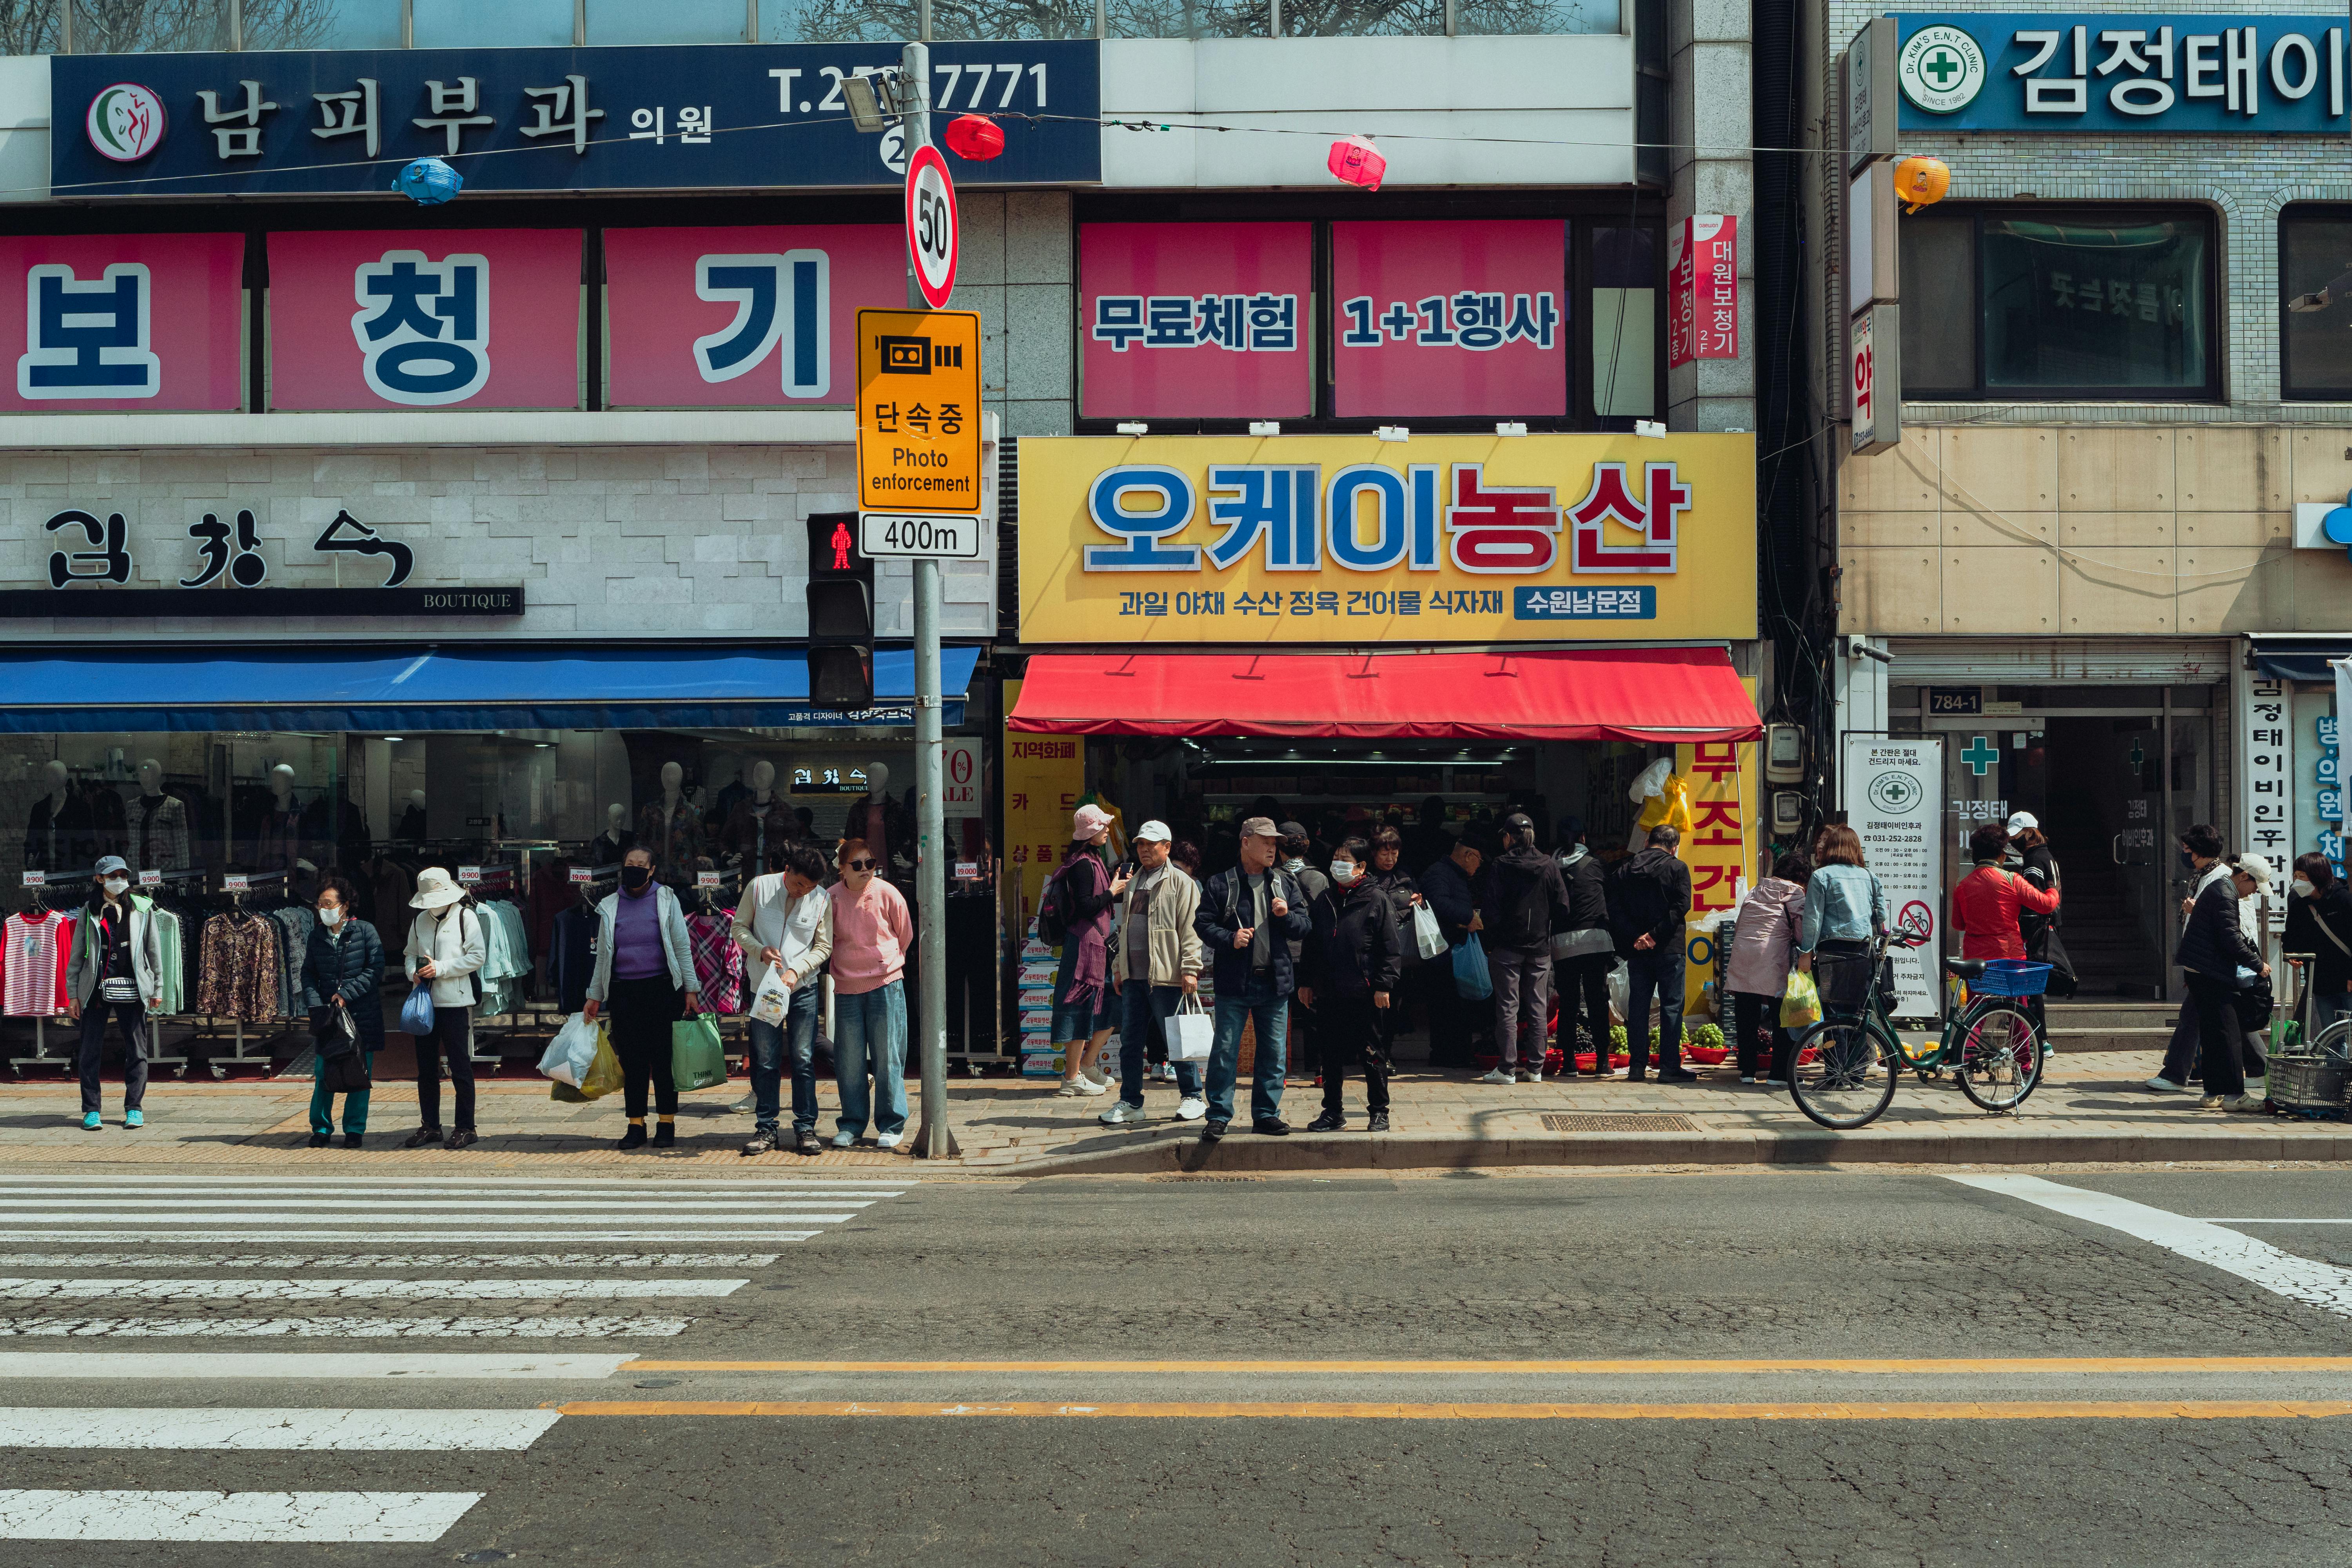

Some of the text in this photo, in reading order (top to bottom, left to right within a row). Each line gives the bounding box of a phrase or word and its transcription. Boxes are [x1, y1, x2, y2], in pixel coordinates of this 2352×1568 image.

[1961, 42, 1978, 73] CLINIC
[2012, 25, 2344, 116] 김정태이
[1855, 85, 1867, 115] 김정태
[1922, 93, 1966, 105] SINCE 1982
[629, 106, 711, 145] 의원
[919, 188, 947, 260] 50
[1681, 253, 1693, 355] 보청기
[1713, 241, 1733, 354] 대원보청기
[1093, 293, 1298, 352] 무료체험
[1342, 291, 1559, 350] 1+1행사
[1855, 344, 1872, 420] 약
[876, 401, 963, 434] 단속중
[1858, 426, 1873, 443] 252-6665
[893, 448, 947, 467] Photo
[872, 473, 969, 492] enforcement
[1083, 462, 1691, 574] 오케이농산
[885, 521, 957, 550] 400m
[424, 593, 511, 608] BOUTIQUE
[1118, 590, 1642, 616] 과일 야채 수산 정육 건어물 식자재 수원남문점
[1934, 695, 1976, 709] 784-1
[788, 712, 810, 720] 고품격
[813, 712, 842, 720] 디자이너
[1012, 742, 1075, 759] 지역화폐
[1907, 780, 1917, 796] CLINIC
[1953, 800, 2007, 819] 김정태
[1692, 743, 1741, 911] 무조건
[1866, 822, 1922, 830] 김정태이비인후과
[693, 1069, 712, 1078] THINK
[694, 1076, 713, 1086] GREEN
